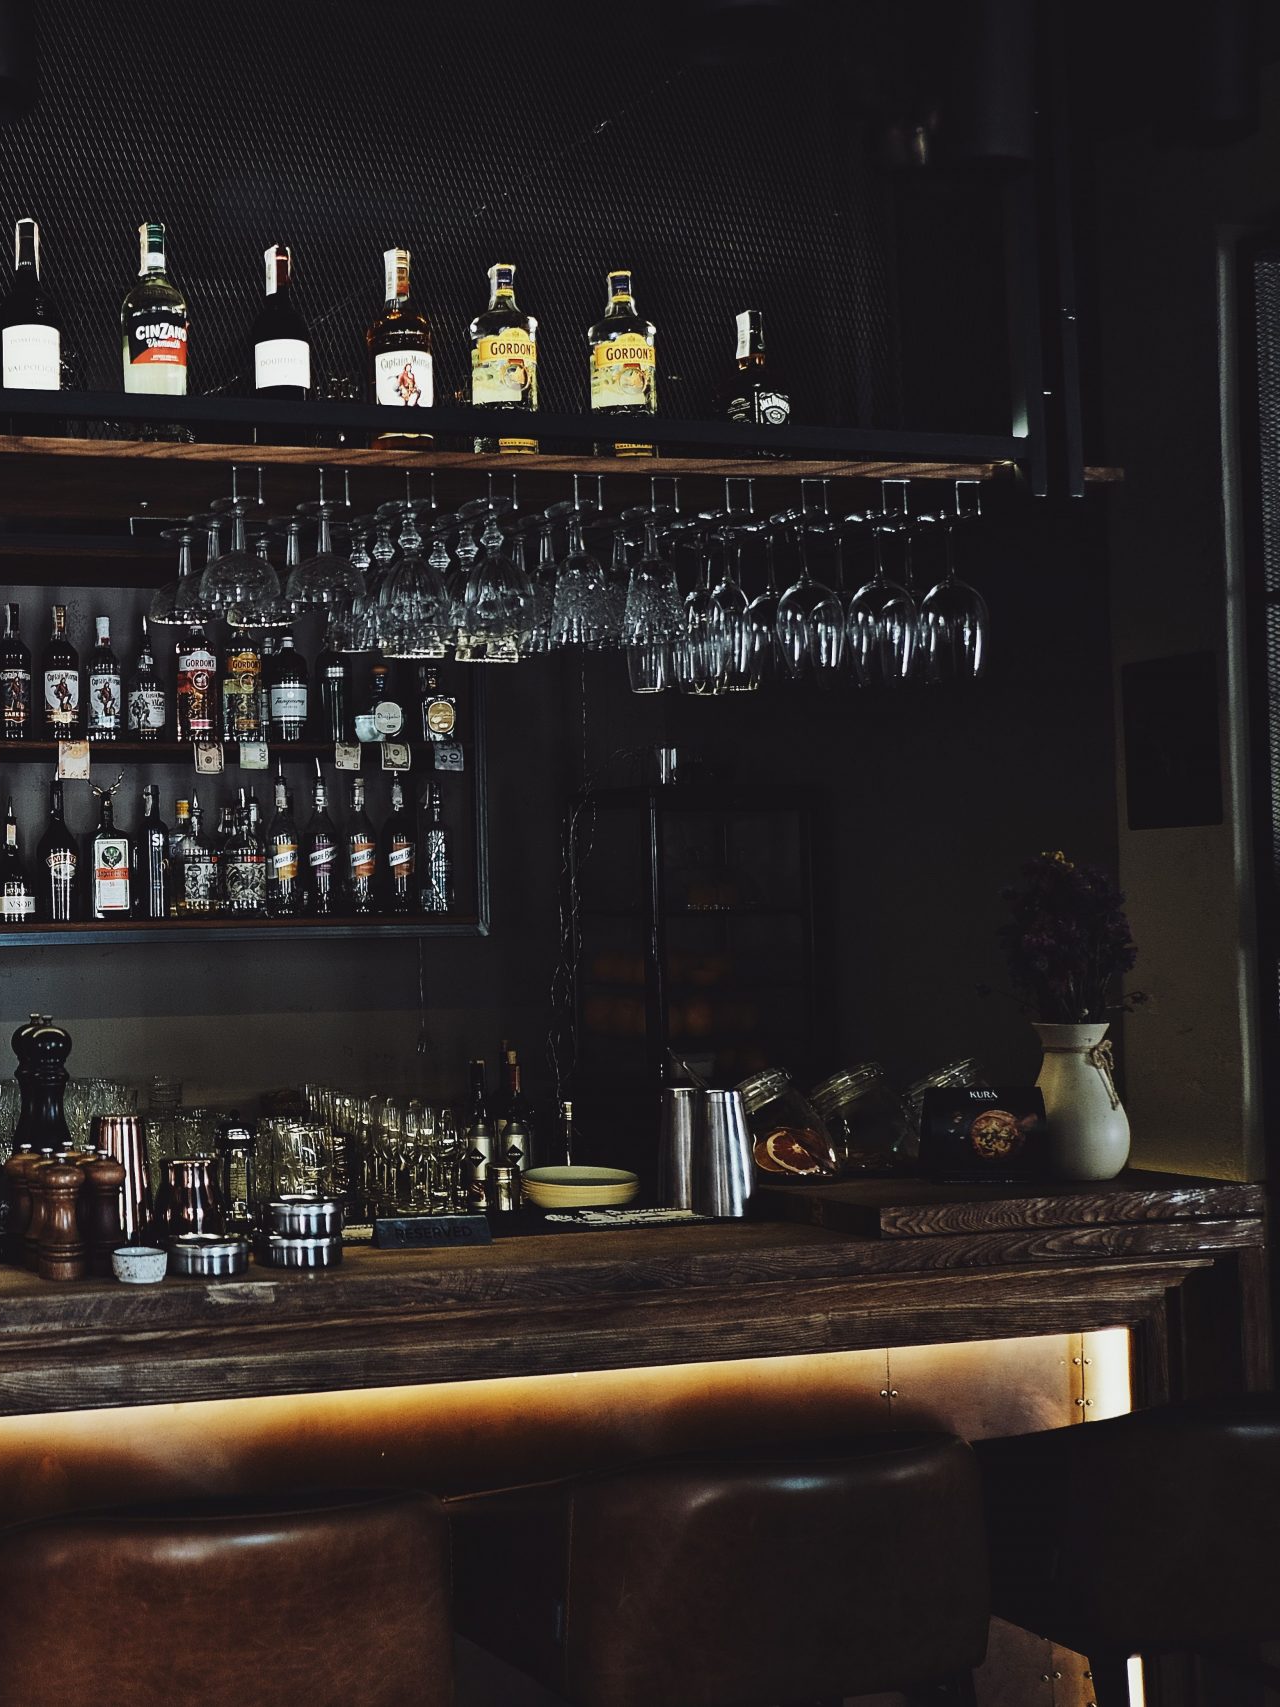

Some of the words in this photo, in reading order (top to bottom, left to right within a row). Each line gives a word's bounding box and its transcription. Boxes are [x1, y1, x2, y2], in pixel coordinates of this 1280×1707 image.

[135, 322, 187, 342] CINZANO
[490, 342, 536, 356] GORDON'S
[606, 347, 653, 361] GORDON'S
[395, 1225, 472, 1240] RESERVED
